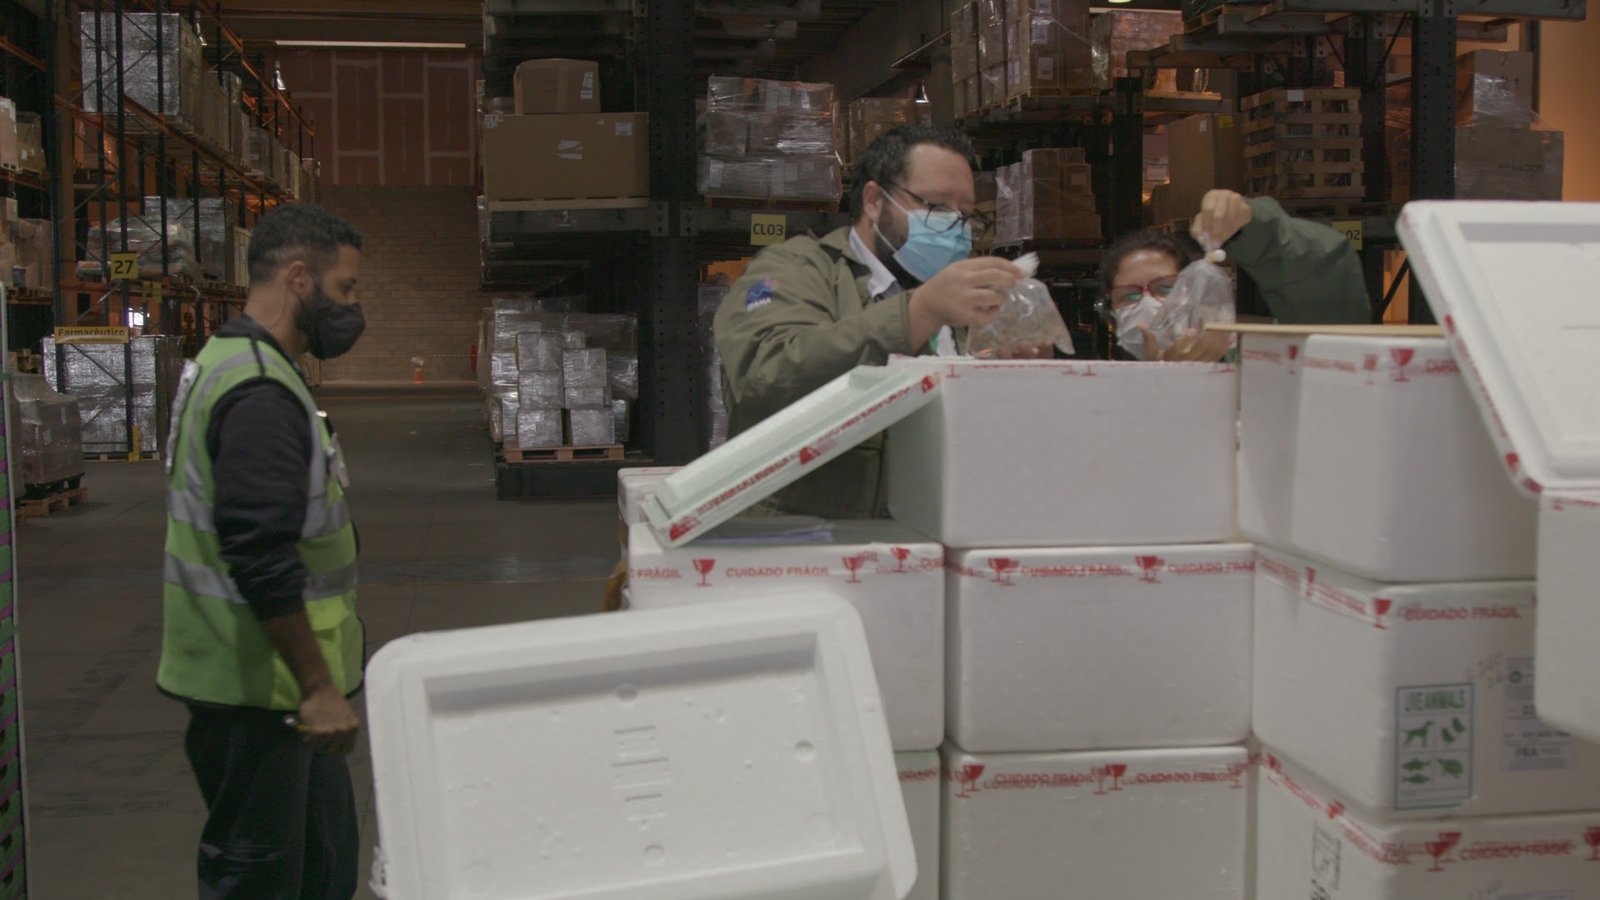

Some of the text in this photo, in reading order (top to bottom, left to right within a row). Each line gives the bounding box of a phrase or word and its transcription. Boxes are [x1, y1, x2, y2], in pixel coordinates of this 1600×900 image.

[752, 223, 784, 236] CL03
[1339, 229, 1361, 240] 02
[114, 260, 134, 274] 27
[726, 564, 831, 578] CUIDADO FRÁGIL
